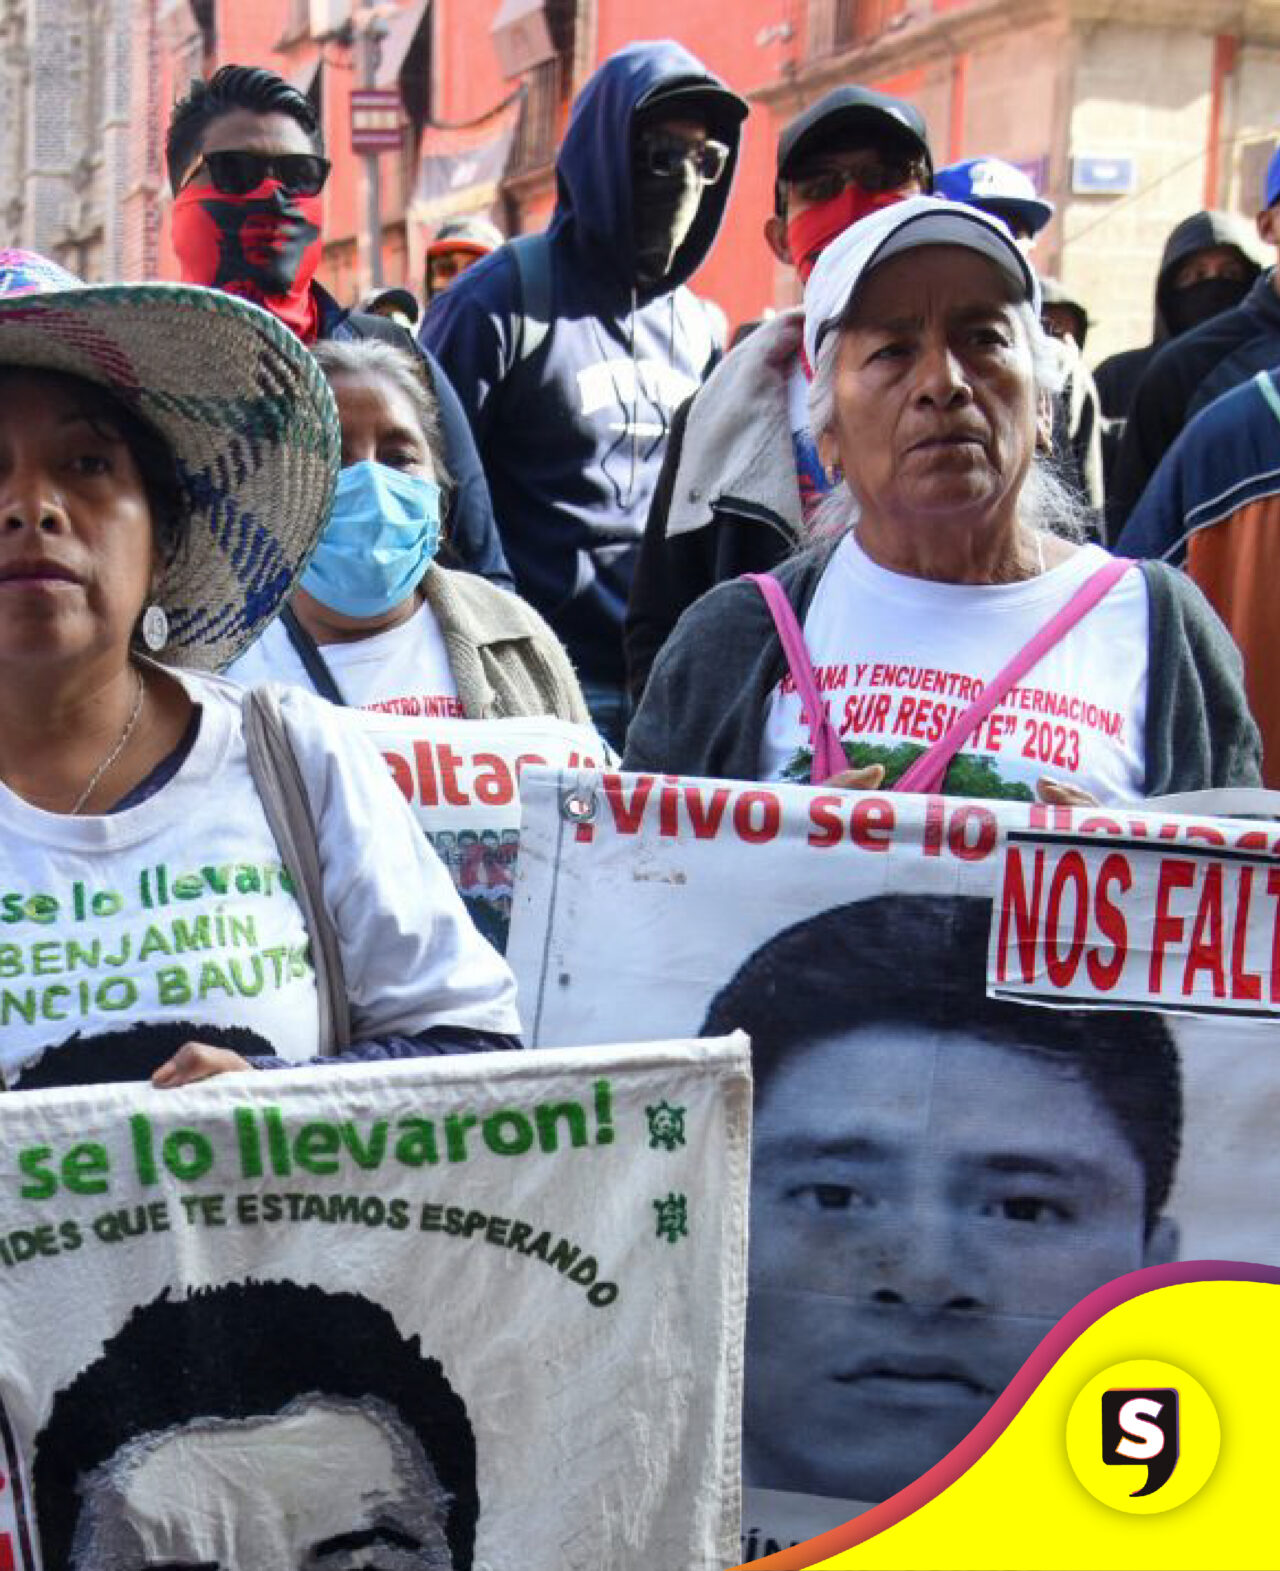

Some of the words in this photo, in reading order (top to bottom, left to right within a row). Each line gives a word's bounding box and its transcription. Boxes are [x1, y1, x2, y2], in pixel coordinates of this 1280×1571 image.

[839, 693, 891, 735] SUR
[1022, 718, 1079, 772] 2023
[855, 664, 868, 687] Y
[871, 664, 985, 702] ENCUENTRO
[996, 687, 1126, 745] TERNACIONAL
[808, 795, 895, 852] se
[923, 793, 998, 862] lo
[0, 892, 61, 924] se
[73, 880, 123, 922] lo
[997, 846, 1133, 991] NOS
[19, 1140, 110, 1200] se
[129, 1112, 214, 1186] lo
[233, 1078, 616, 1179] llevaron!
[93, 1200, 171, 1243] QUE
[180, 1195, 228, 1227] TE
[237, 1193, 410, 1231] ESTAMOS
[420, 1203, 619, 1308] ESPERANDO
